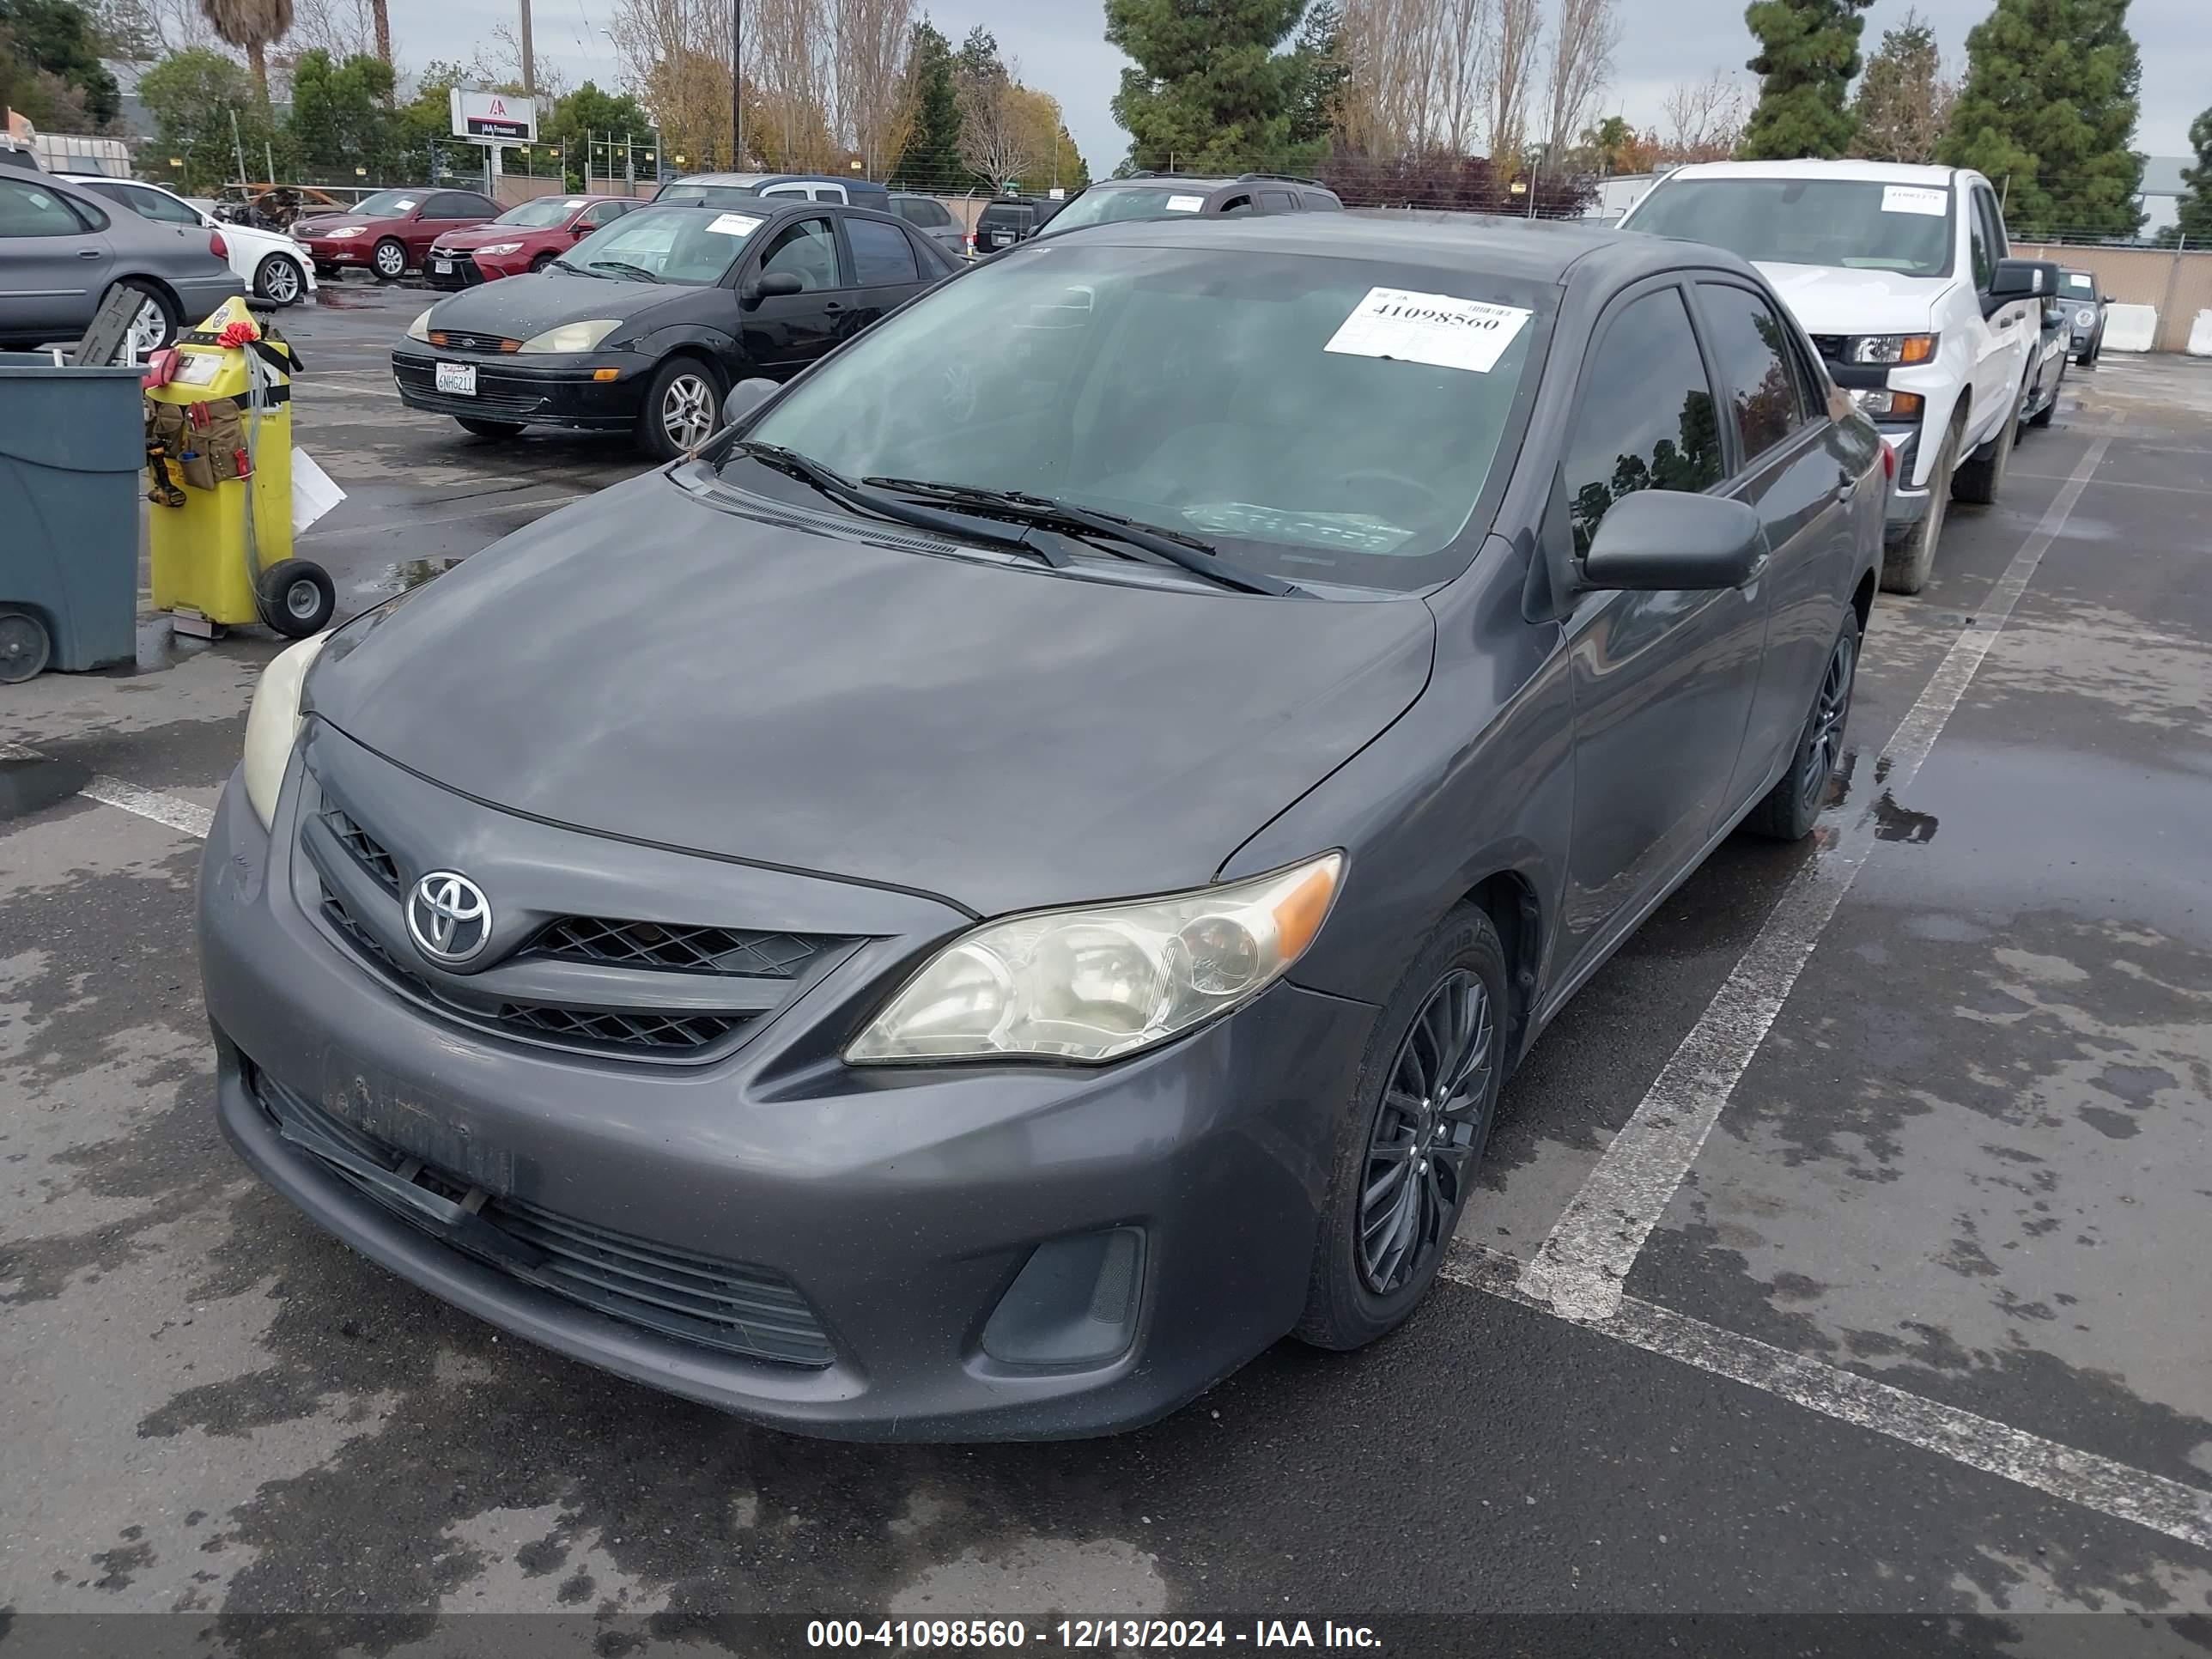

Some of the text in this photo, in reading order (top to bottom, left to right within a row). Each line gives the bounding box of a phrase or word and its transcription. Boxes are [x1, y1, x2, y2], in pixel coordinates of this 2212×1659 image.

[494, 125, 517, 135] Fremont
[1372, 303, 1500, 331] 41098560
[439, 374, 473, 391] 6NHG211
